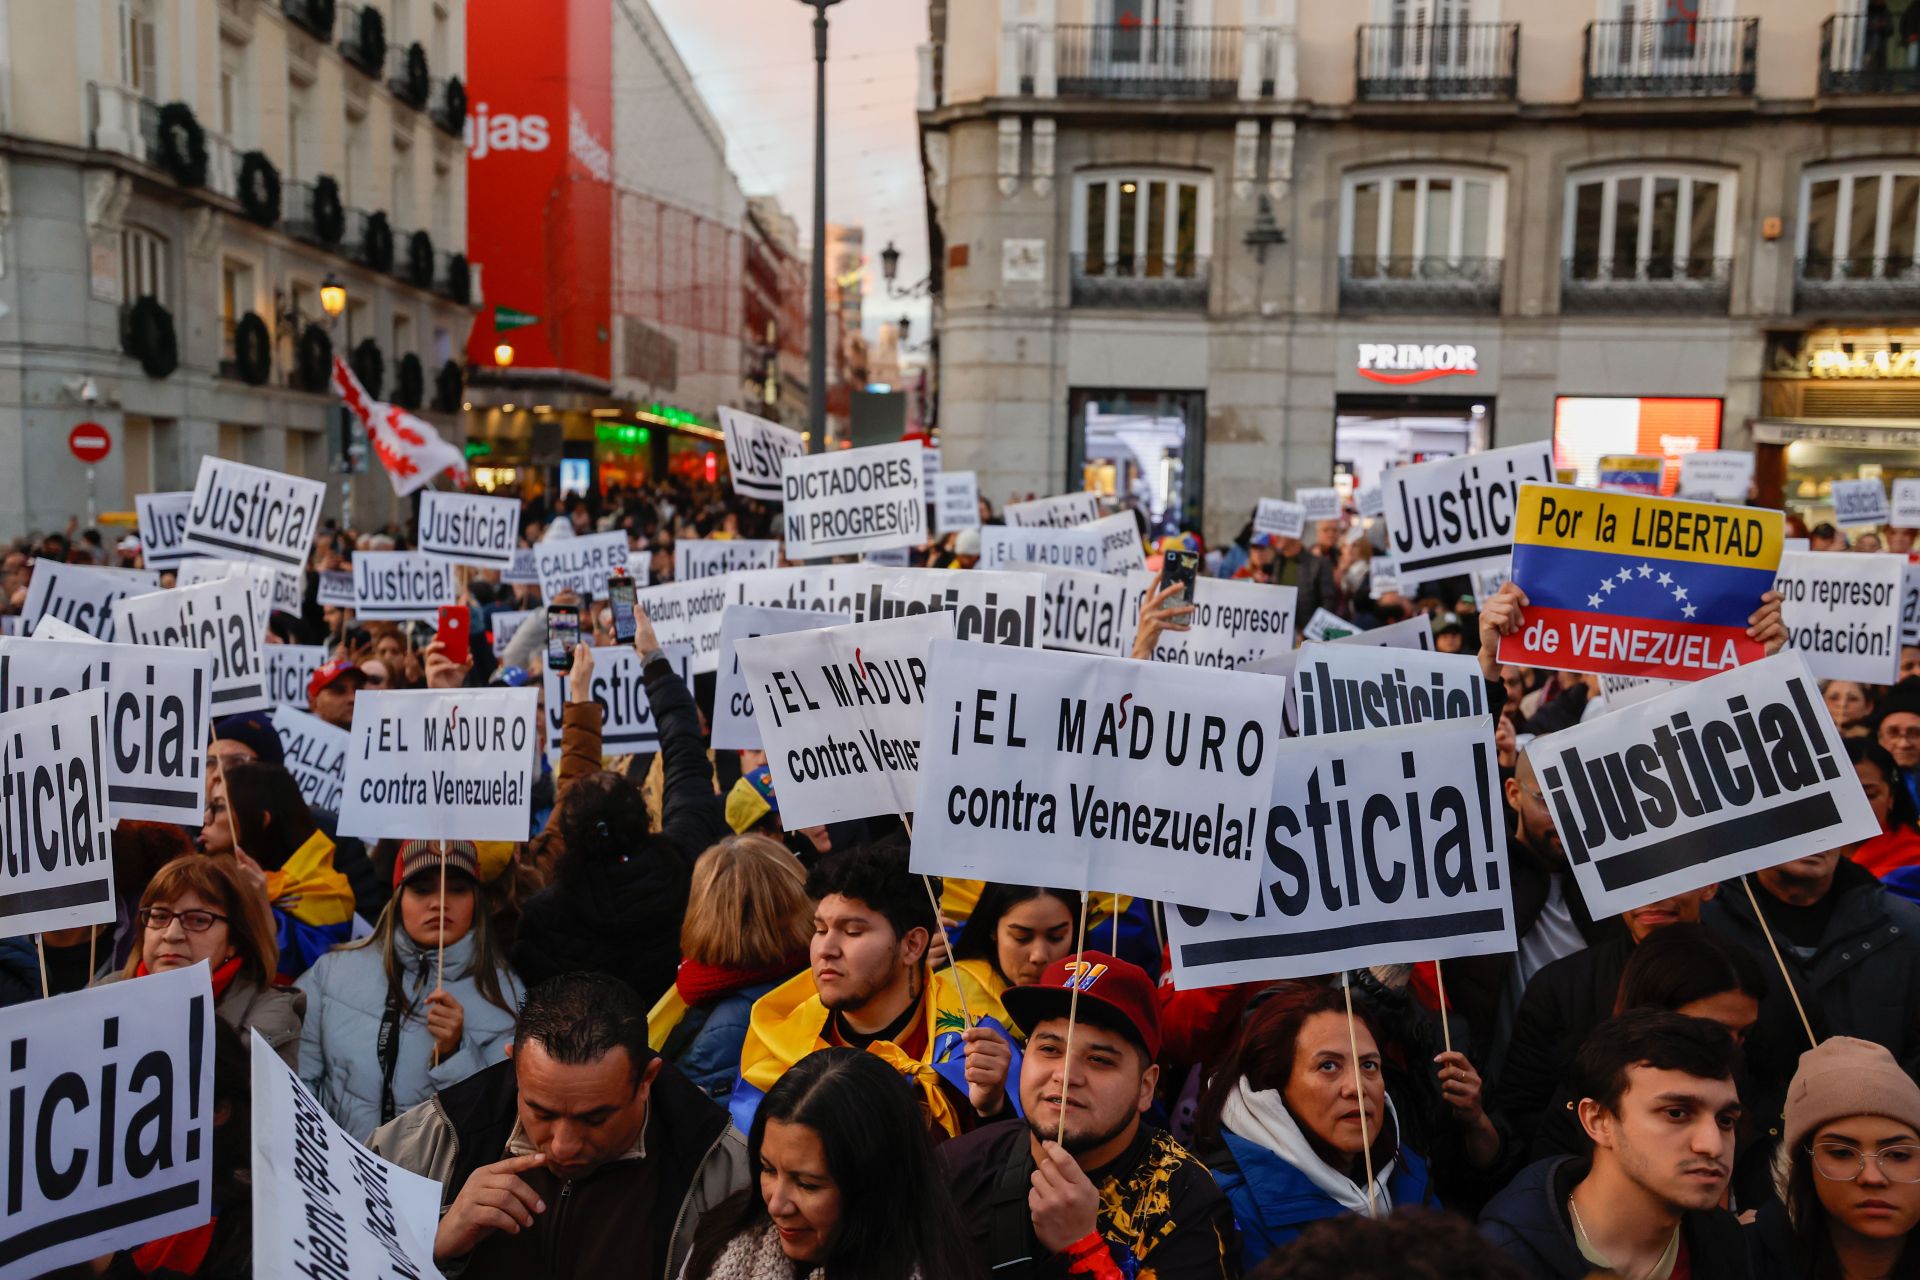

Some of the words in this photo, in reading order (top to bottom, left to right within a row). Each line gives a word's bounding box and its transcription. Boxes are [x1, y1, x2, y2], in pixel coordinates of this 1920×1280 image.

[1356, 344, 1478, 371] PRIMOR
[786, 458, 918, 501] DICTADORES,
[1395, 455, 1552, 552] Justici
[145, 504, 192, 549] Jus
[193, 469, 318, 550] Justicia!
[422, 498, 515, 550] Justicia!
[788, 516, 806, 542] NI
[811, 499, 920, 541] PROGRES(¡!)
[1537, 496, 1583, 539] Por
[1596, 502, 1617, 544] la
[1631, 507, 1763, 558] LIBERTAD
[358, 556, 451, 601] Justicia!
[541, 548, 603, 577] CALLAR
[607, 544, 628, 566] ES
[1026, 543, 1098, 567] MADURO
[1215, 604, 1289, 638] represor
[1811, 578, 1894, 612] represor
[128, 590, 260, 681] ticia!
[1523, 618, 1560, 655] de
[1570, 622, 1740, 671] VENEZUELA
[1787, 621, 1892, 657] votación!
[764, 670, 821, 728] ¡EL
[365, 718, 408, 759] ¡EL
[787, 733, 861, 784] contra
[862, 729, 921, 773] Vene
[951, 688, 1027, 756] ¡EL
[1058, 697, 1264, 777] MADURO
[0, 715, 106, 878] ticia!
[360, 773, 428, 804] contra
[431, 772, 524, 808] Venezuela!
[1543, 677, 1841, 864] ¡Justicia!
[947, 779, 1058, 834] contra
[1070, 783, 1257, 861] Venezuela!
[1177, 742, 1500, 928] sticia!
[7, 995, 205, 1216] icia!
